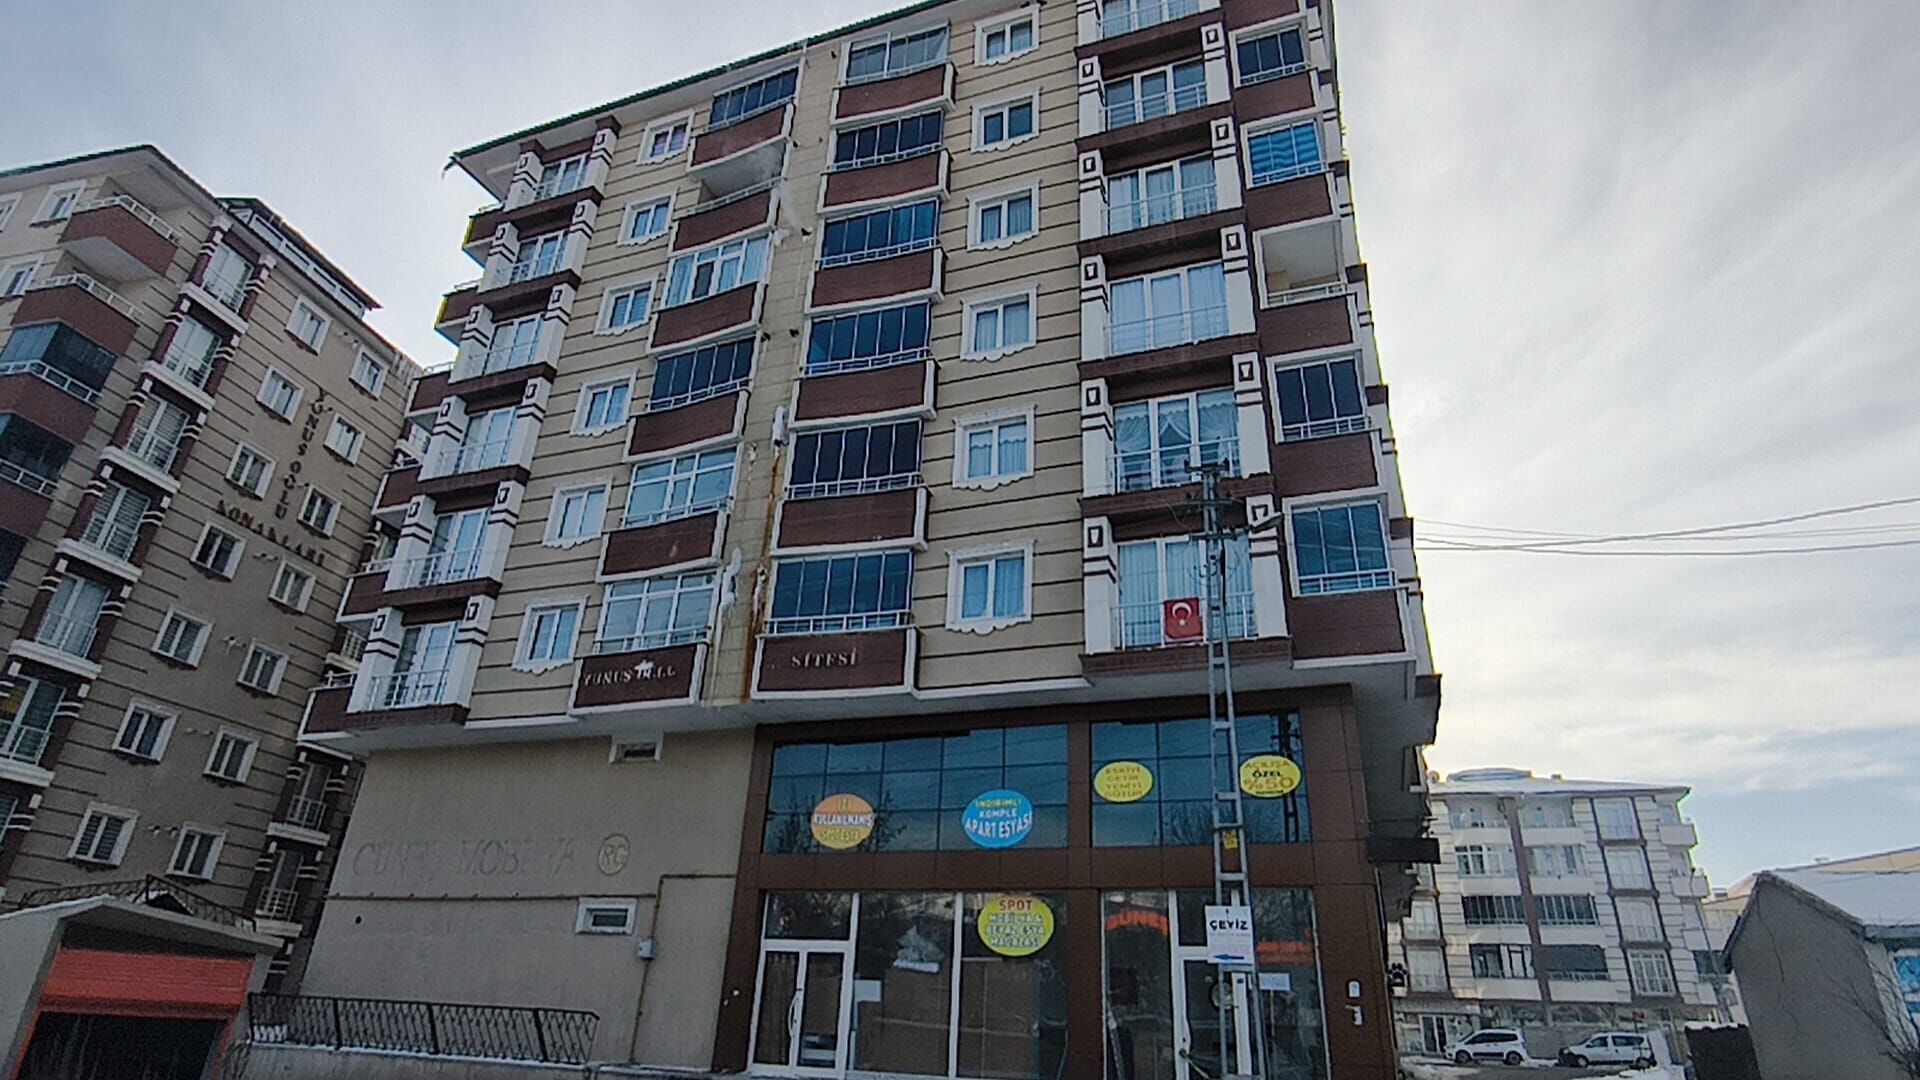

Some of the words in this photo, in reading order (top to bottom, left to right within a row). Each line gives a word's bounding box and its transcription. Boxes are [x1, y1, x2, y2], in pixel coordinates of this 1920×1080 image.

[1252, 769, 1283, 778] ÖZEL
[979, 808, 1017, 818] KOMPLE
[965, 817, 997, 839] APART
[1000, 899, 1033, 911] SPOT
